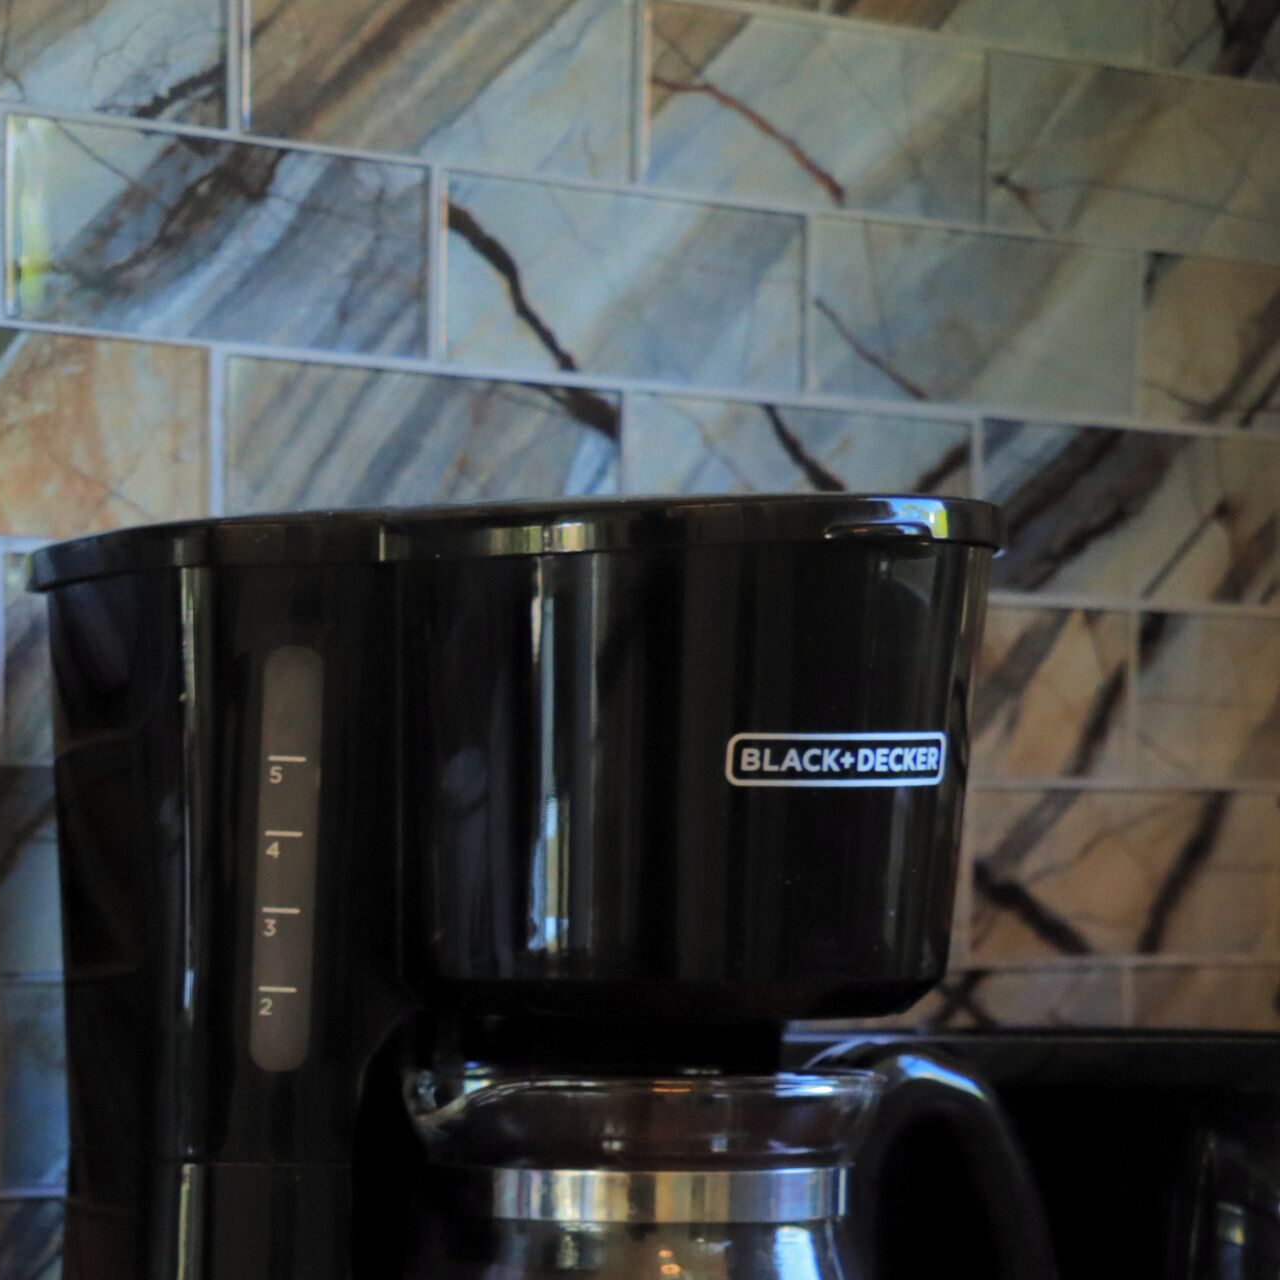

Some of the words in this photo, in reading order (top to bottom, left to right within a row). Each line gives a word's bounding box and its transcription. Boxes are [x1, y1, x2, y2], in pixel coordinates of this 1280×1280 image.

[740, 747, 939, 773] BLACK+DECKER
[269, 766, 283, 784] 5
[265, 841, 281, 859] 4
[262, 918, 277, 936] 3
[258, 998, 273, 1016] 2
